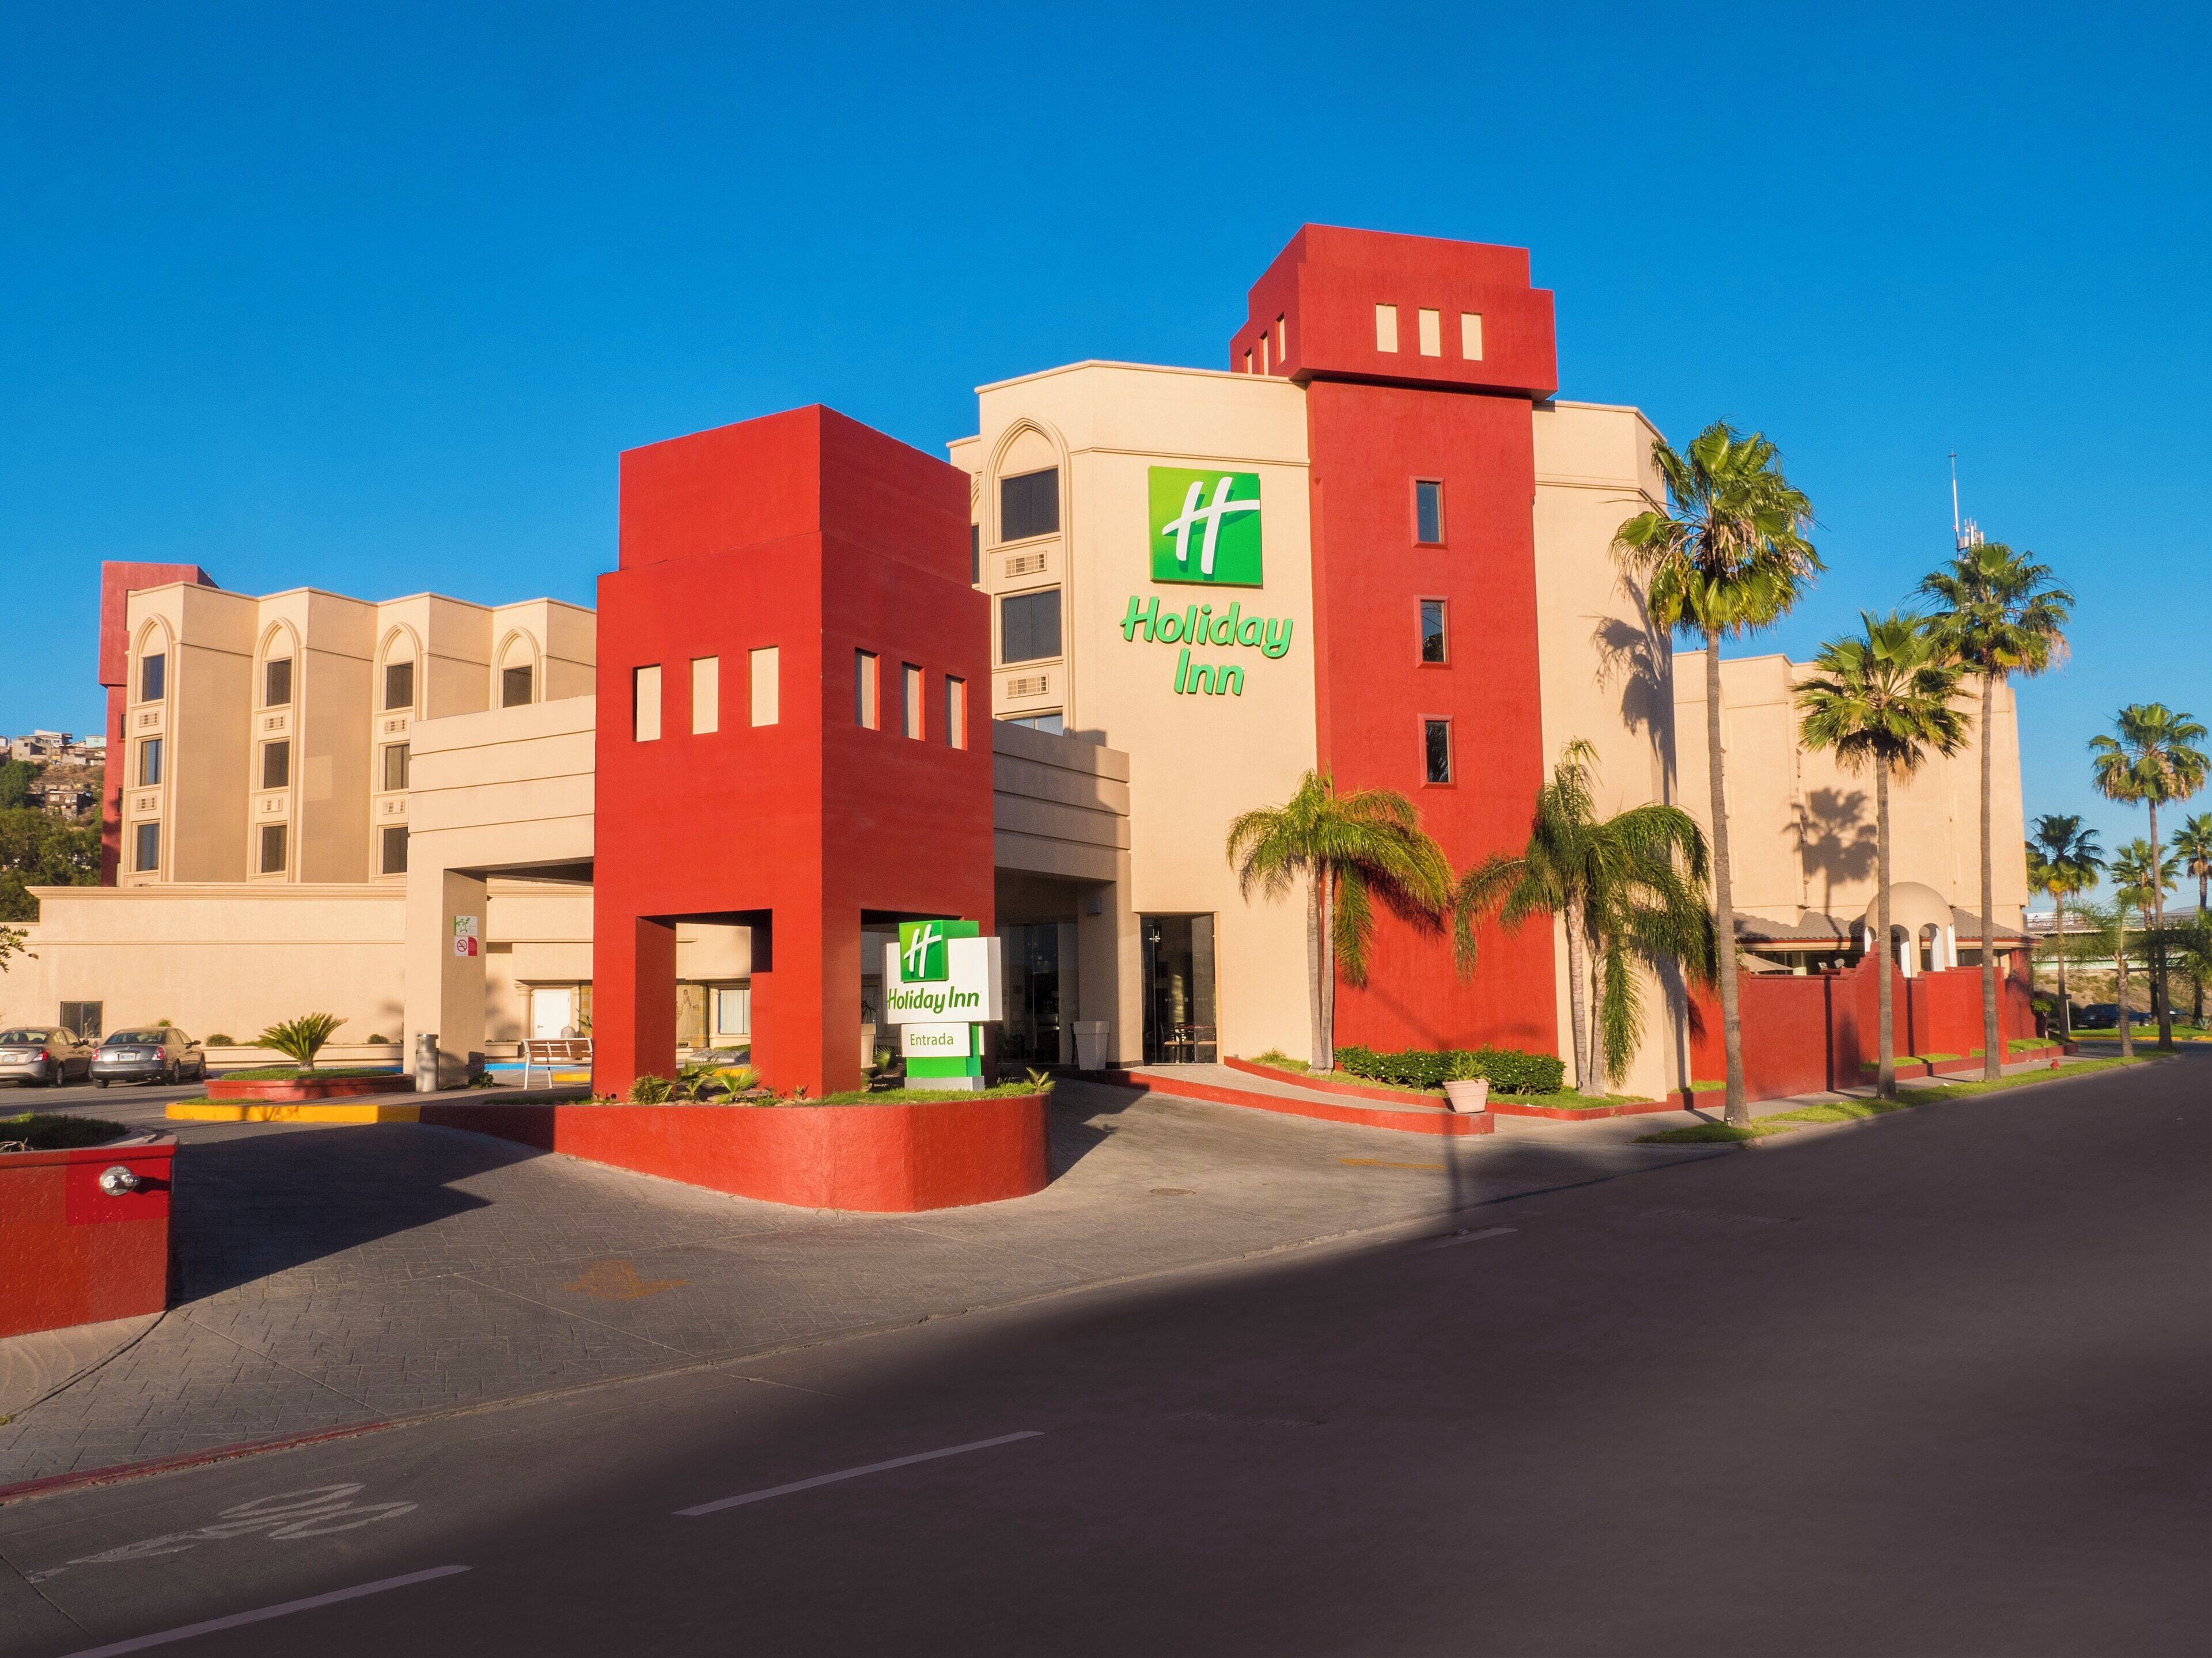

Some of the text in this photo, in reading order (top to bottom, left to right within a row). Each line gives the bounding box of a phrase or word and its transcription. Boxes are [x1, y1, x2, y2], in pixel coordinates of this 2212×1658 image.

[1120, 595, 1294, 659] Holiday
[1173, 648, 1244, 695] Inn
[887, 985, 980, 1015] Holiday Inn
[910, 1032, 955, 1046] Entrada
